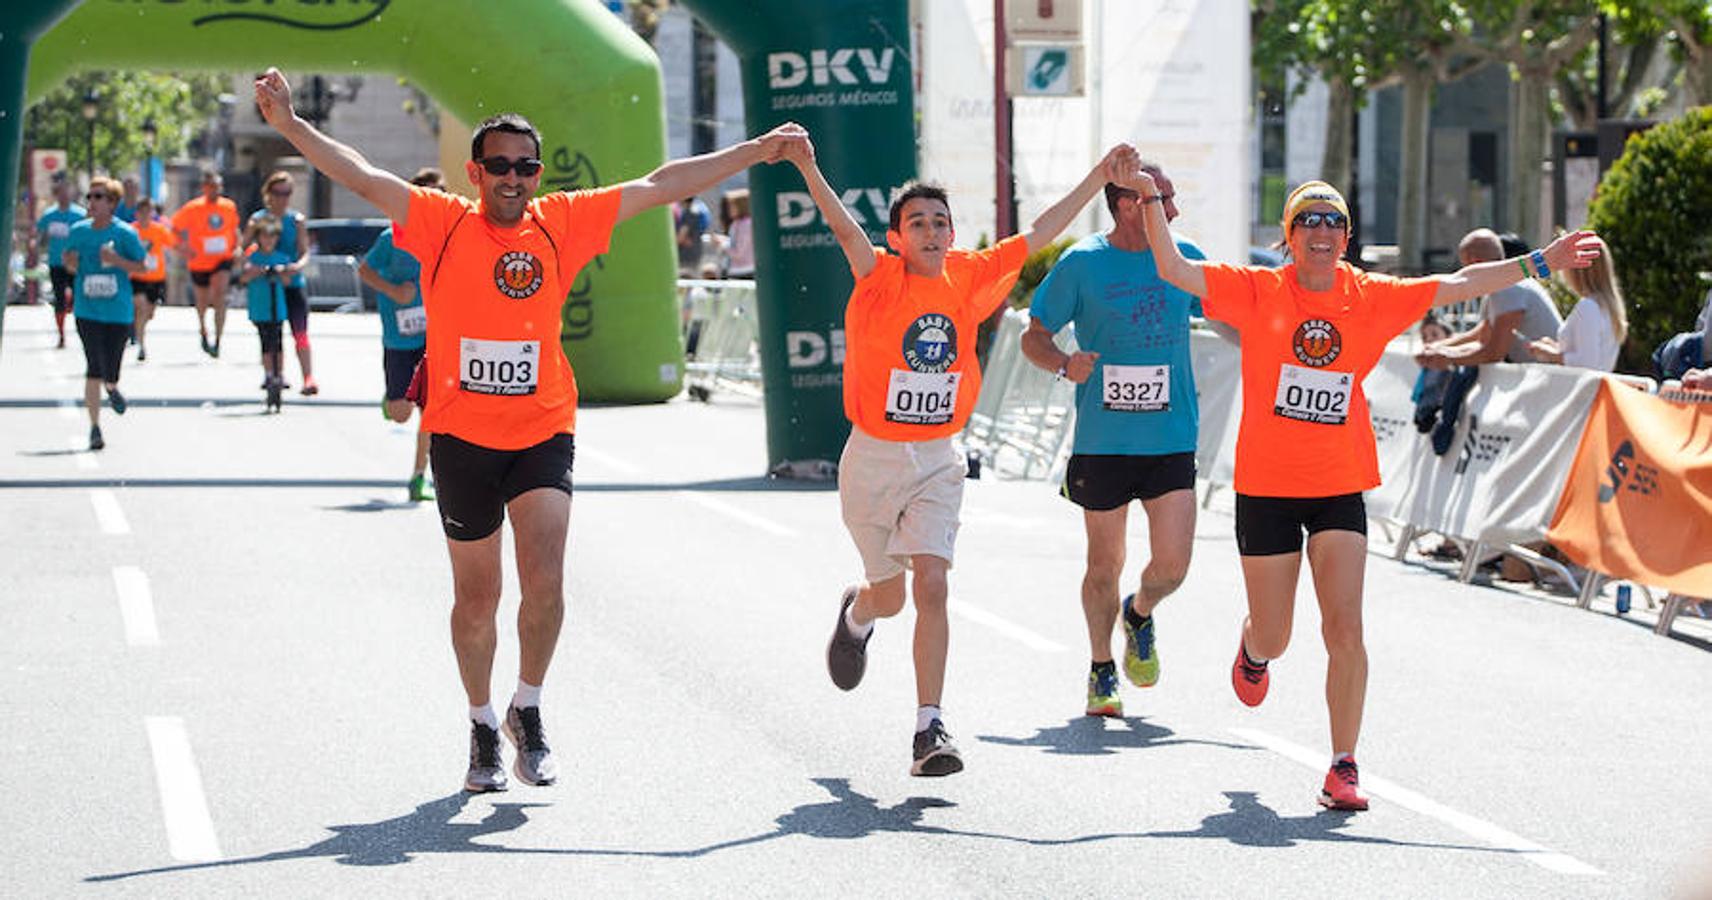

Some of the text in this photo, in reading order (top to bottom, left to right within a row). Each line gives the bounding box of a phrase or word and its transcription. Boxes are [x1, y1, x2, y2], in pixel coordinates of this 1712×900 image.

[768, 48, 895, 89] DKV
[772, 90, 899, 110] SEGUROS MÉDICOS
[780, 231, 837, 247] SEGURO
[918, 316, 951, 330] BABY
[468, 358, 532, 383] 0103
[896, 389, 953, 414] 0104
[1107, 381, 1164, 401] 3327
[1286, 385, 1346, 413] 0102
